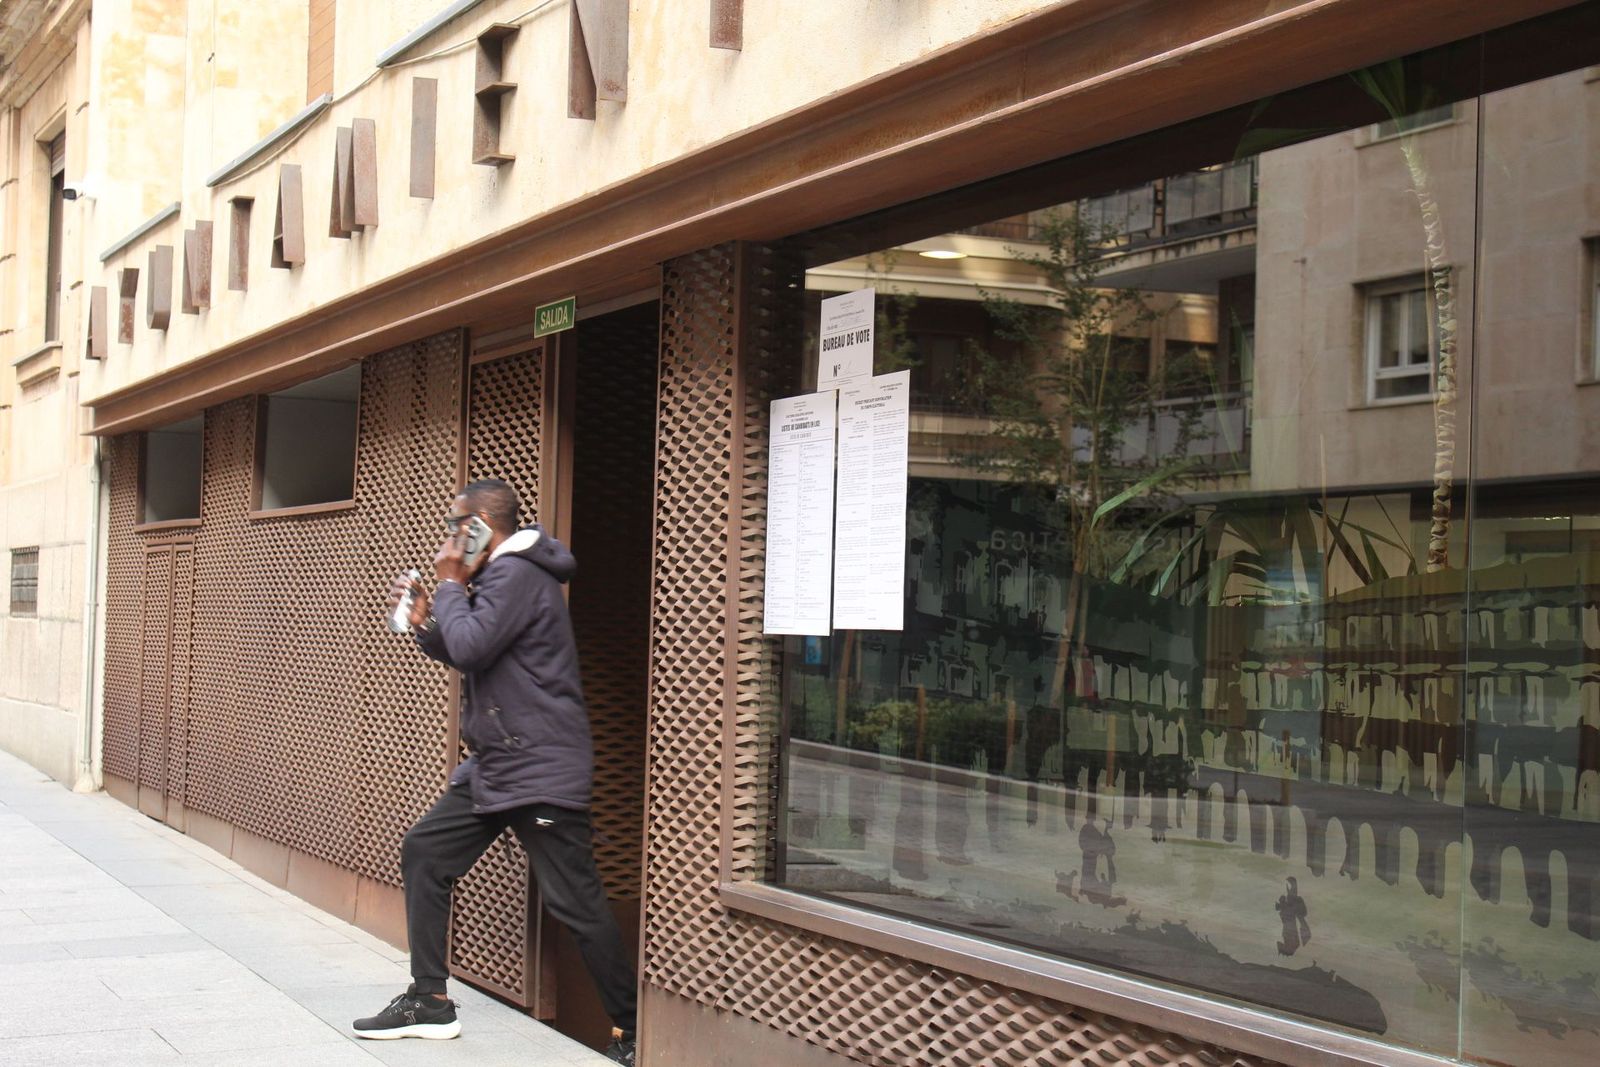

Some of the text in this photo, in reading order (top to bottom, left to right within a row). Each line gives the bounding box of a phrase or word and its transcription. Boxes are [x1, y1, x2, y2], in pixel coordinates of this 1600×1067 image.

[85, 0, 743, 360] AYUNTAMIEN
[541, 305, 568, 330] SALIDA
[823, 329, 870, 352] BUREAU DE VOTE
